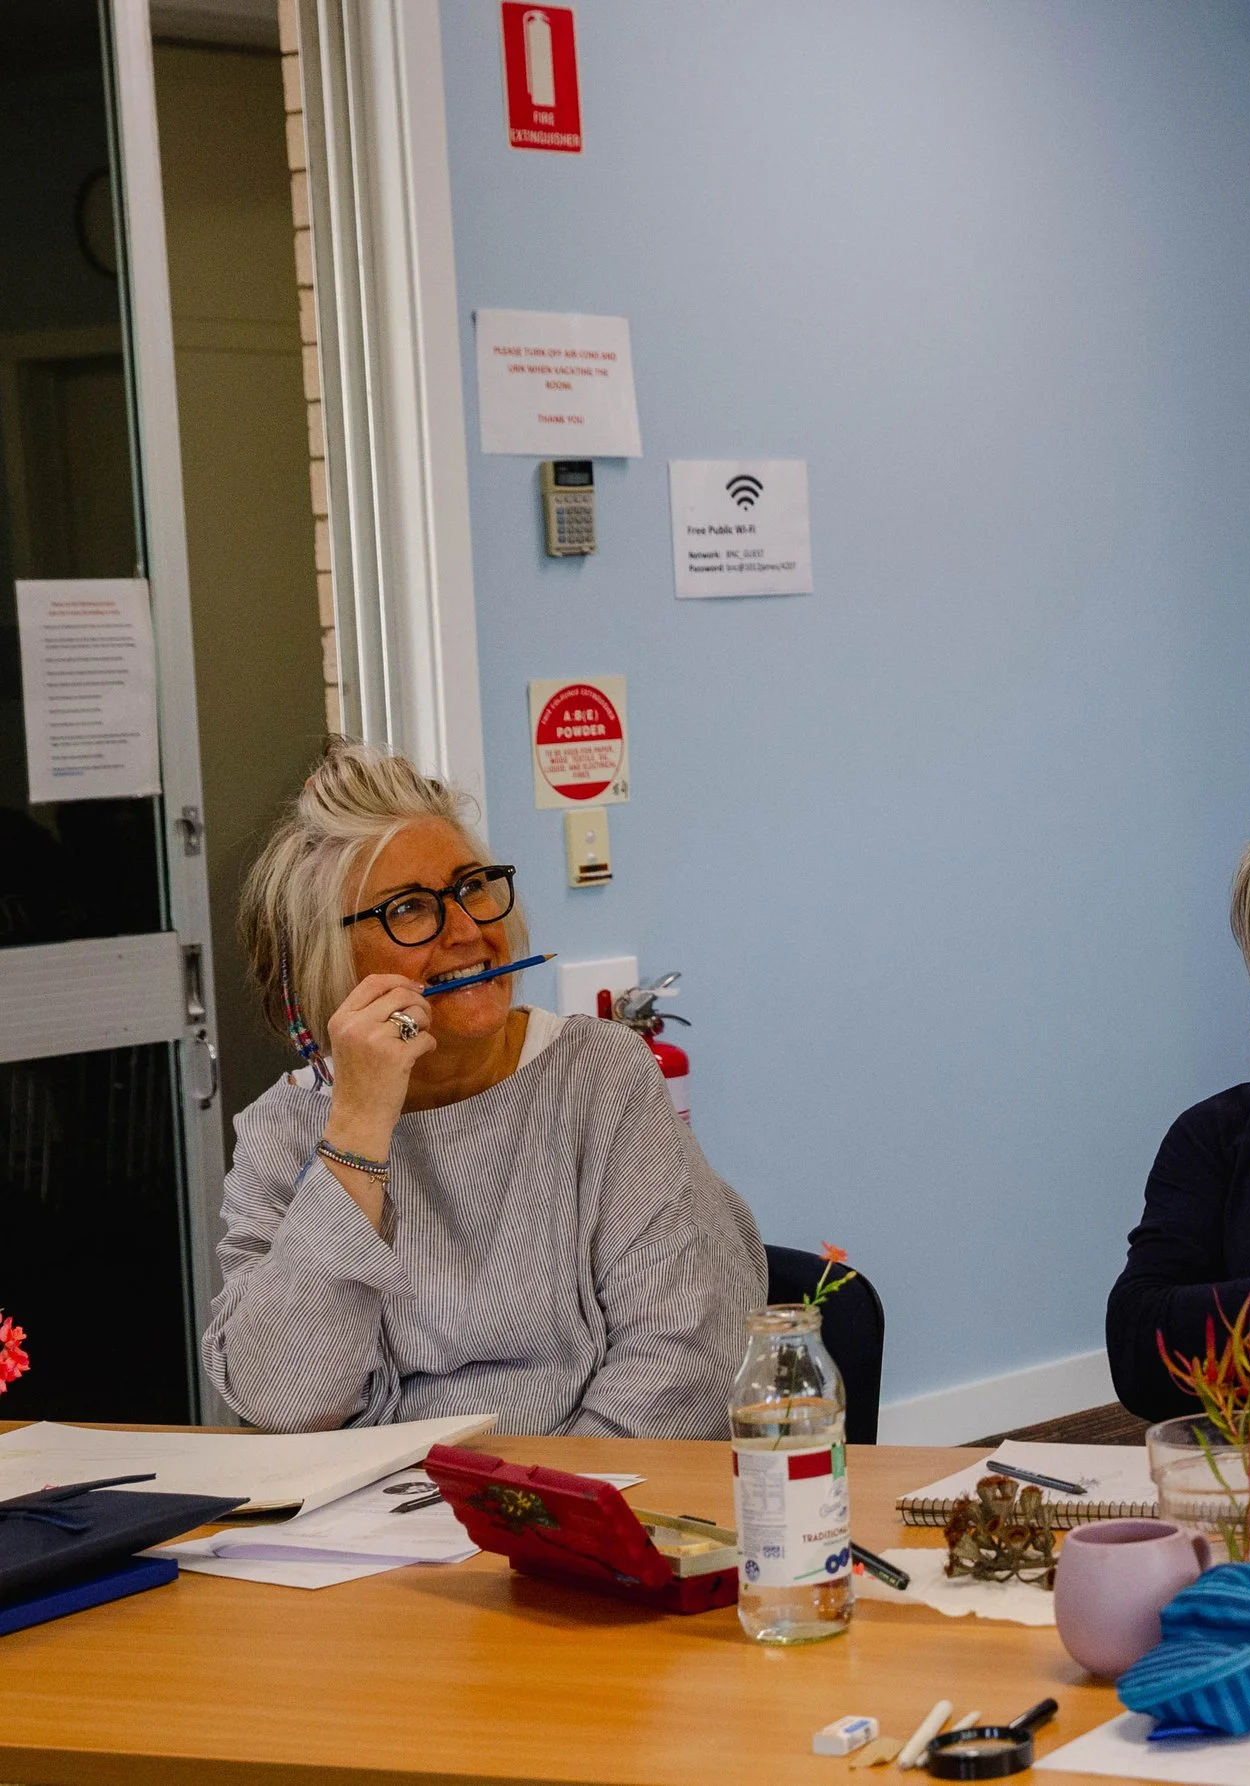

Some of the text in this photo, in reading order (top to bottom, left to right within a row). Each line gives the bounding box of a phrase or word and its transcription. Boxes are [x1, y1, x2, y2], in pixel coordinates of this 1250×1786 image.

[532, 111, 555, 126] FIRE
[511, 128, 581, 147] EXTINGUISHER
[493, 345, 522, 356] PLEASE
[524, 347, 545, 357] TURN
[547, 348, 562, 358] OFF
[564, 349, 577, 359] AIR
[601, 351, 617, 361] AND
[527, 364, 552, 374] WHEN
[554, 365, 592, 376] VACATING
[595, 366, 609, 376] THE
[537, 414, 585, 424] THANK YOU
[687, 525, 706, 535] Free
[708, 524, 733, 535] Public
[688, 551, 721, 559] Network:
[688, 563, 724, 573] Password:
[556, 724, 606, 738] POWDER
